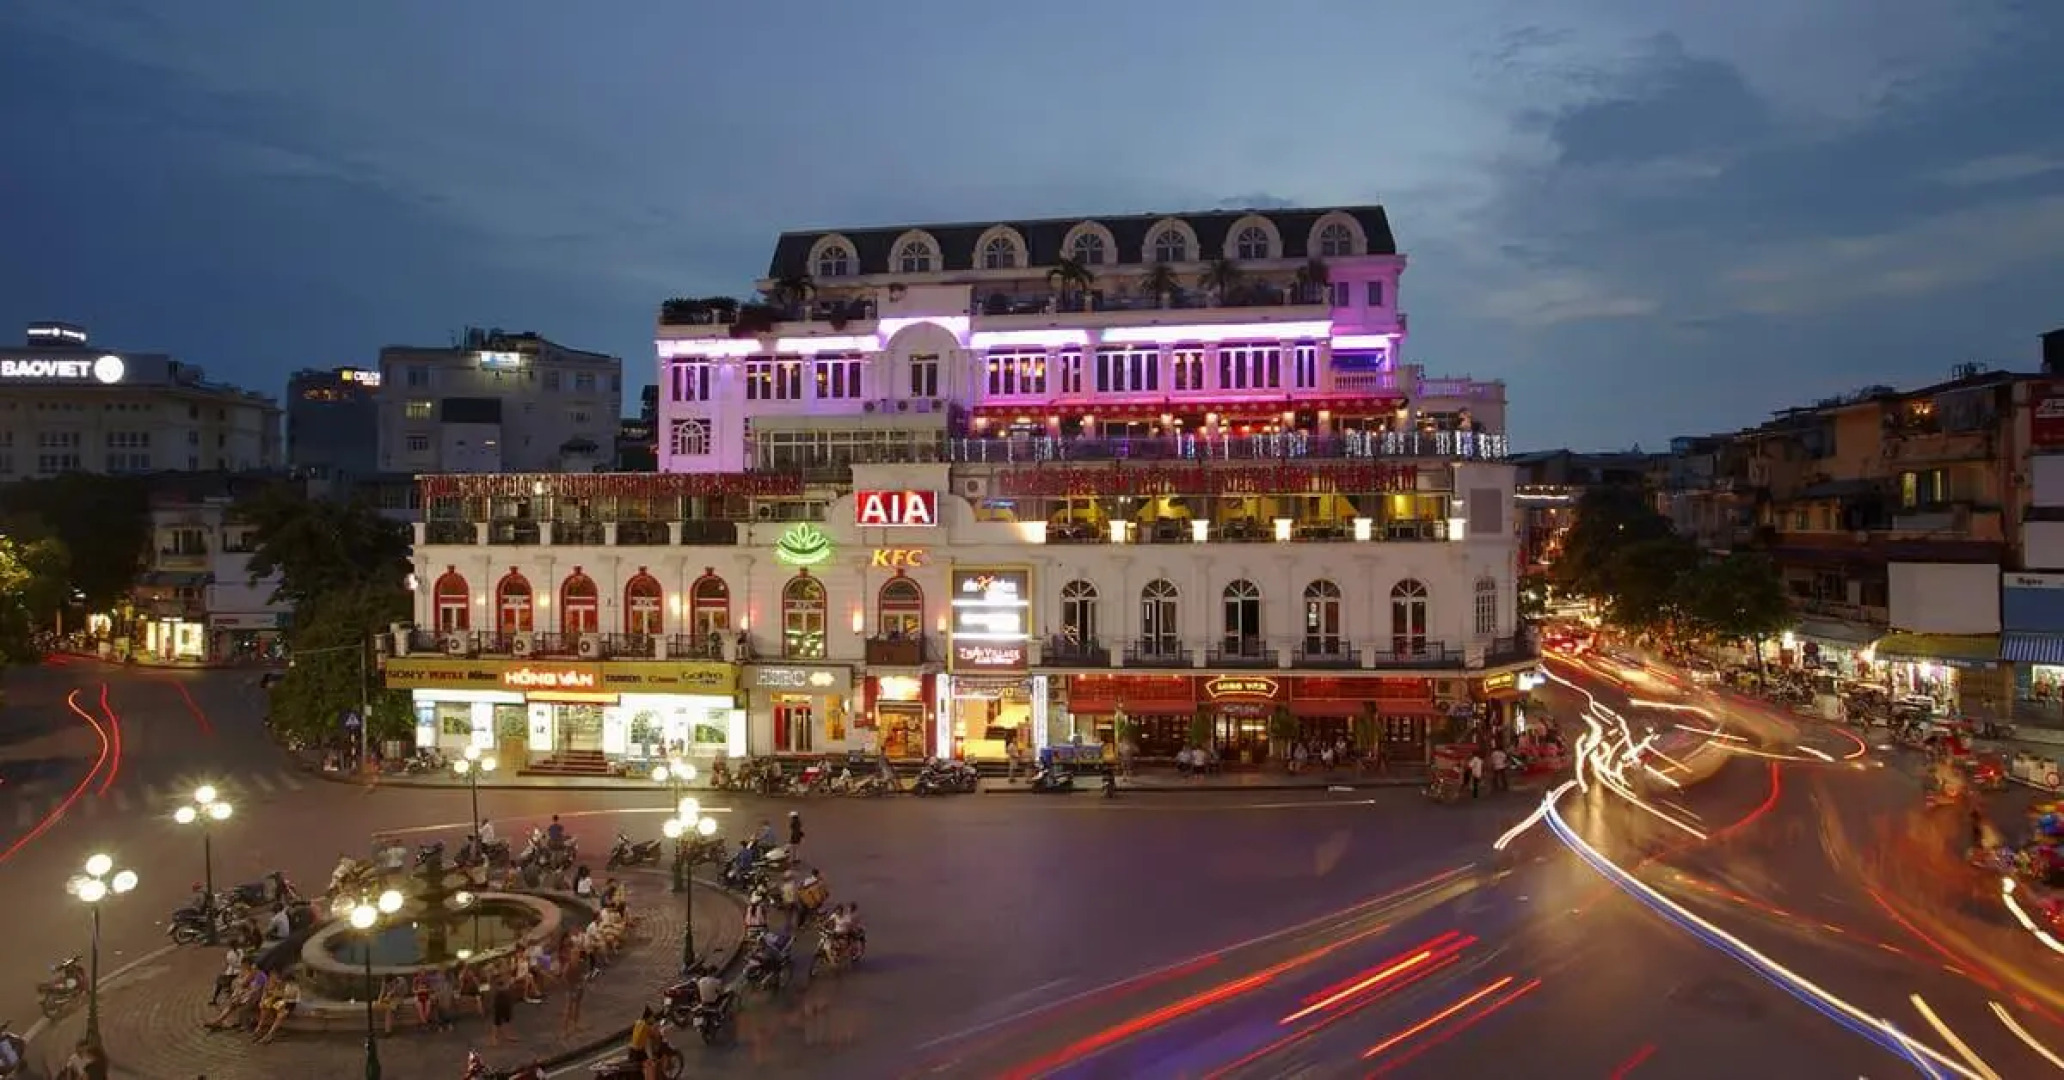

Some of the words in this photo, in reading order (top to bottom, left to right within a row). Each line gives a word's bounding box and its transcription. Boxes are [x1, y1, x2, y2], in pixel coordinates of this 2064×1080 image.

[1, 360, 91, 377] BAOVIET
[861, 494, 930, 523] AIA
[871, 549, 923, 567] KFC
[757, 667, 805, 686] HSBC
